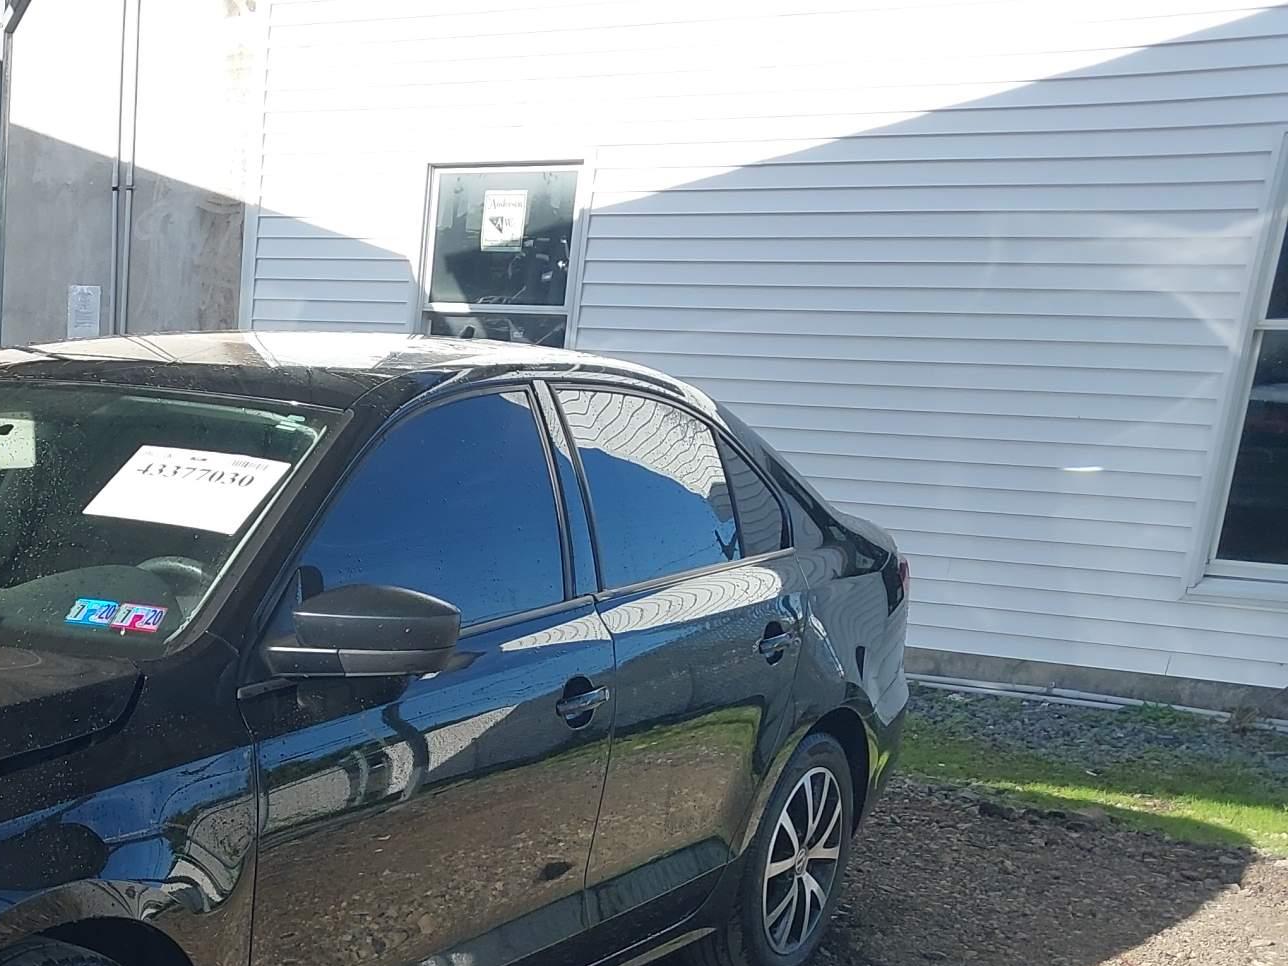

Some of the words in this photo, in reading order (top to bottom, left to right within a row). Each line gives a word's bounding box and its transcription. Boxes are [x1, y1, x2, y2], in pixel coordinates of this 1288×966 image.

[137, 463, 255, 487] 43377030
[73, 604, 85, 618] 7
[98, 604, 116, 620] 20
[144, 609, 163, 626] 20
